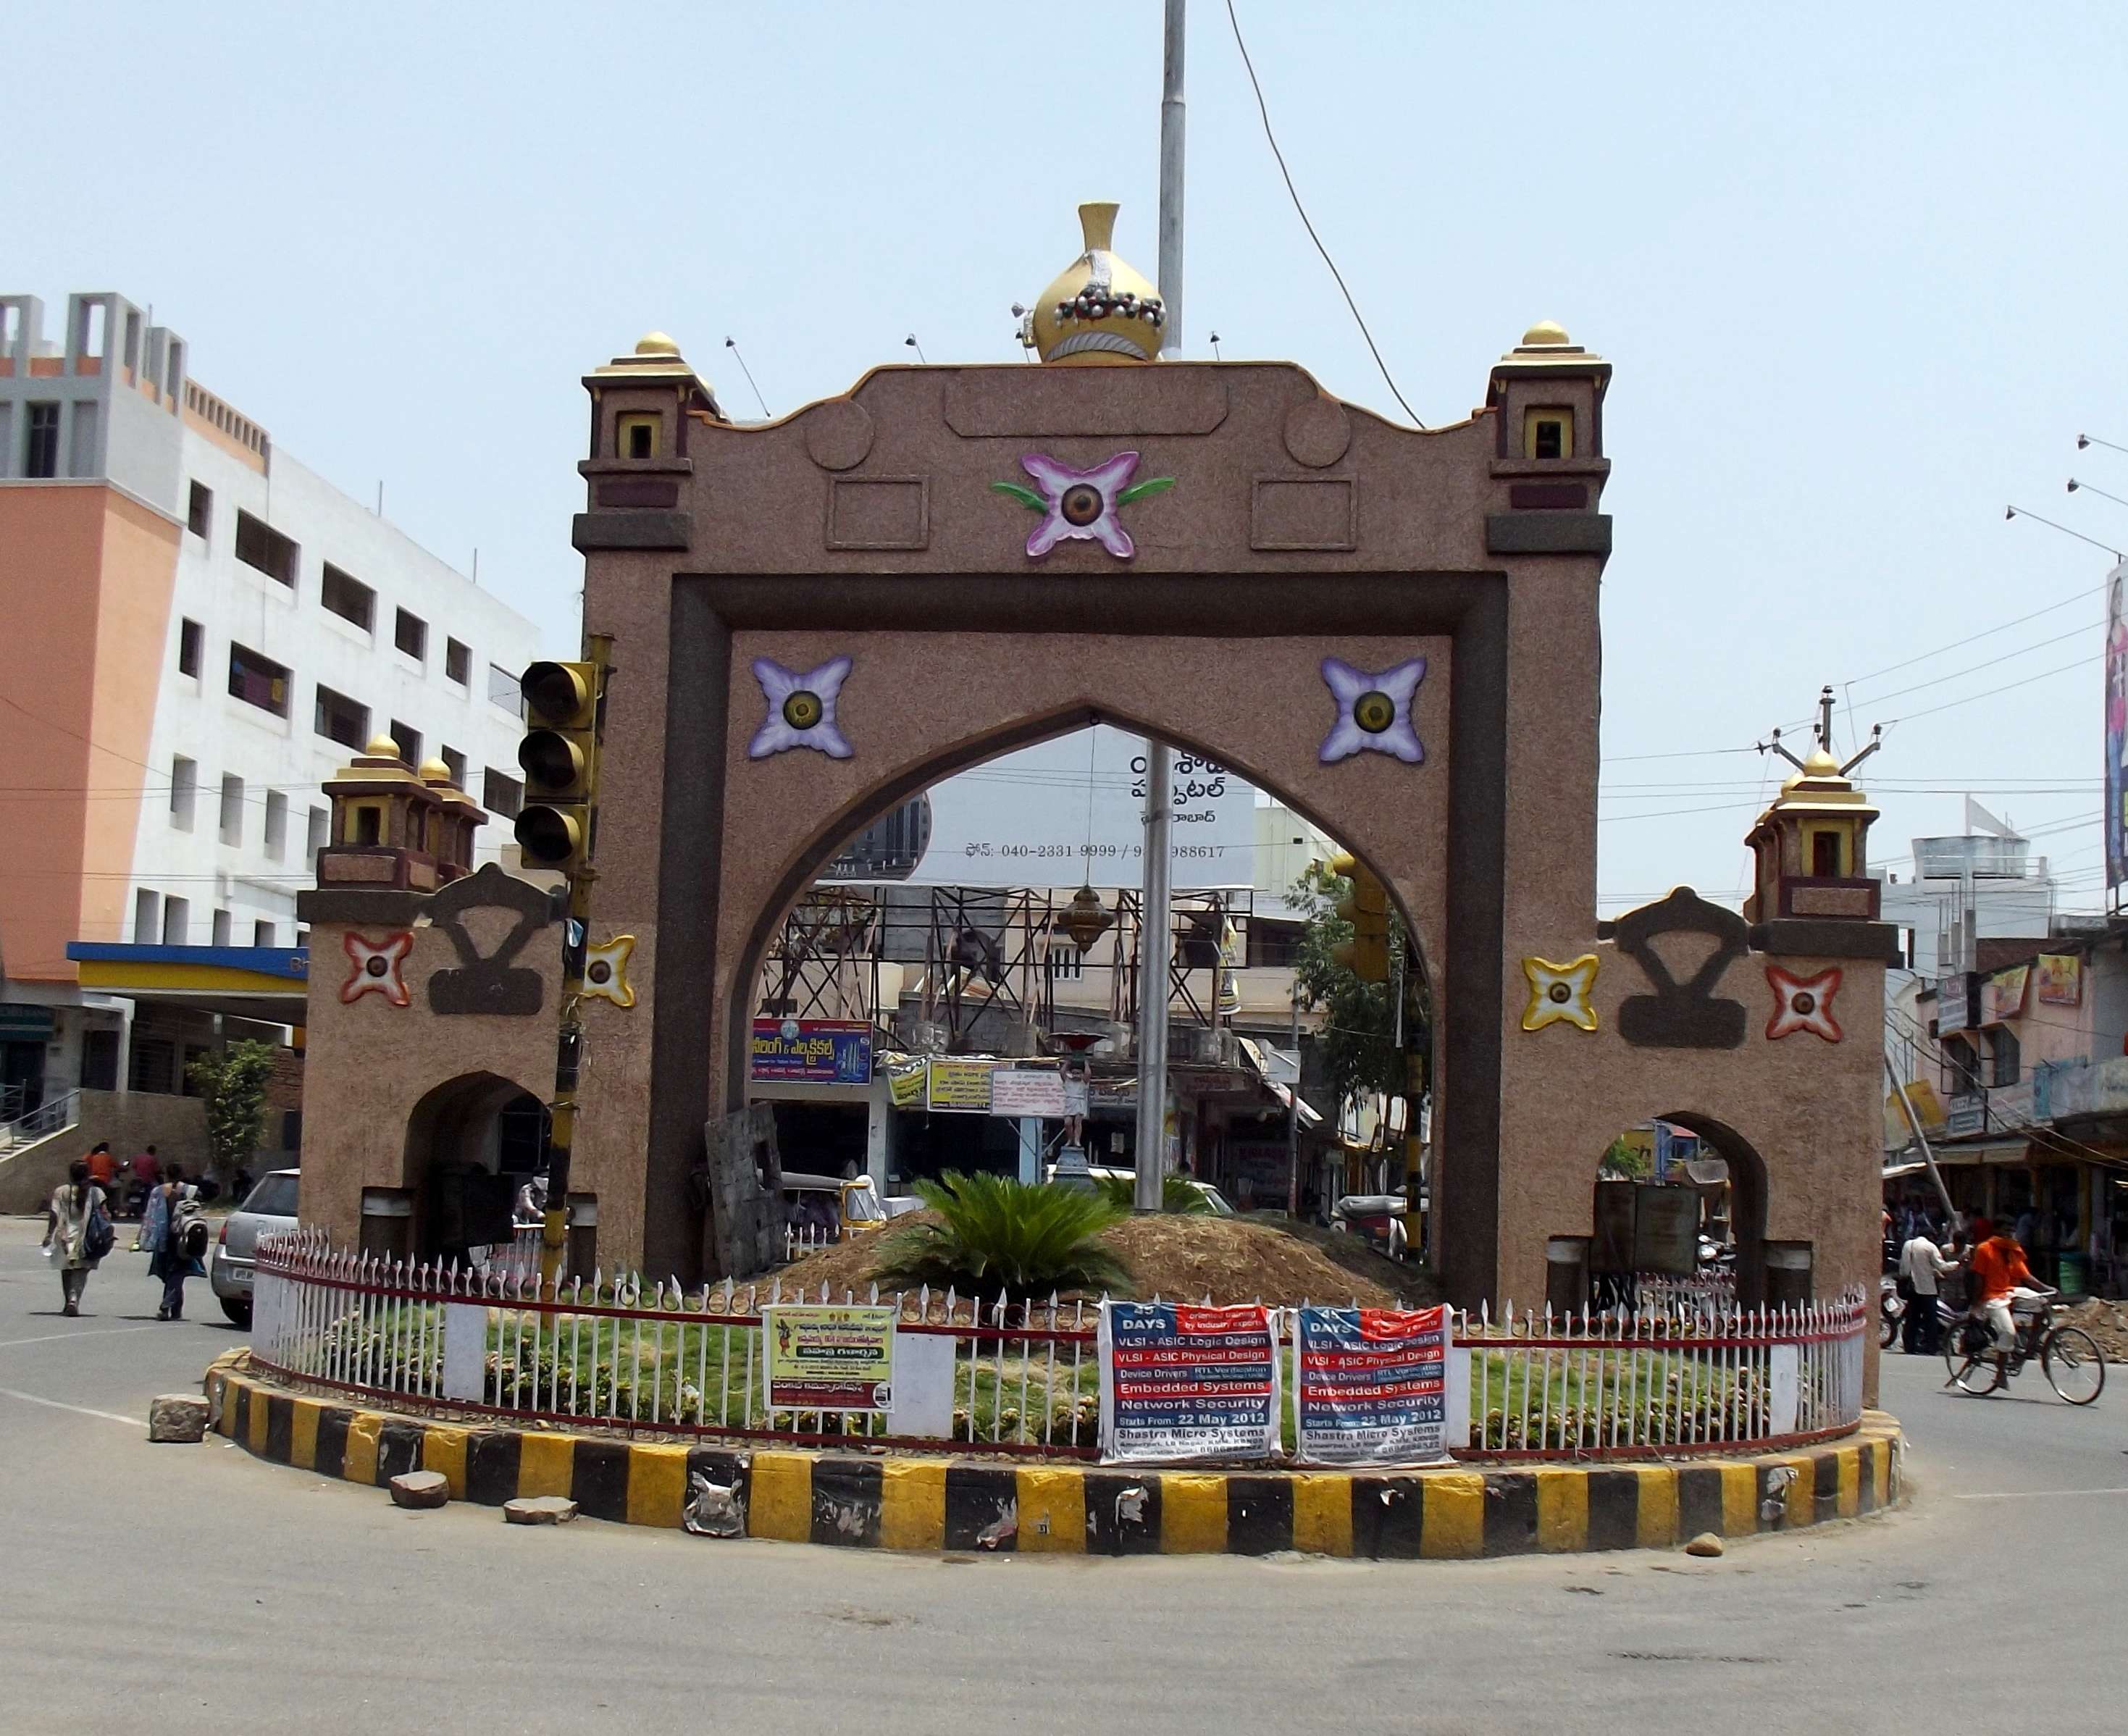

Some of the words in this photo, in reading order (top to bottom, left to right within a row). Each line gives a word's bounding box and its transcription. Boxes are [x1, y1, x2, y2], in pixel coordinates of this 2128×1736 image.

[1002, 844, 1072, 857] 040-2331
[1080, 844, 1116, 857] 9999
[1121, 844, 1128, 860] /
[1122, 1319, 1166, 1330] DAYS
[1310, 1322, 1352, 1333] DAYS
[1118, 1338, 1146, 1347] VLSI
[1157, 1337, 1186, 1346] ASIC
[1190, 1337, 1223, 1349] Logic
[1225, 1335, 1265, 1347] Design
[1309, 1341, 1332, 1349] VLSI
[1343, 1341, 1370, 1351] ASIC
[1372, 1341, 1404, 1351] Logic
[1153, 1353, 1178, 1362] ASIC
[1181, 1351, 1226, 1362] Physical
[1228, 1350, 1265, 1360] Design
[1307, 1356, 1329, 1365] VLSI
[1339, 1356, 1364, 1367] ASIC
[1407, 1350, 1439, 1361] Design
[1155, 1368, 1188, 1378] Drivers
[1338, 1371, 1371, 1380] Drivers
[1121, 1383, 1198, 1393] Embedded
[1203, 1382, 1265, 1393] Systems
[1308, 1385, 1381, 1396] Embedded
[1385, 1379, 1440, 1393] Systems
[1122, 1400, 1190, 1409] Network
[1196, 1399, 1265, 1409] Security
[1308, 1401, 1373, 1412] Network
[1378, 1396, 1441, 1409] Security
[1178, 1414, 1194, 1425] 22
[1199, 1414, 1227, 1426] May
[1231, 1413, 1265, 1423] 2012
[1381, 1414, 1407, 1426] May
[1412, 1409, 1441, 1421] 2012
[1119, 1429, 1166, 1439] Shastra
[1171, 1427, 1207, 1438] Micro
[1211, 1427, 1265, 1441] Systems
[1307, 1430, 1353, 1441] Shastra
[1357, 1430, 1387, 1439] Micro
[1391, 1425, 1441, 1438] Systems
